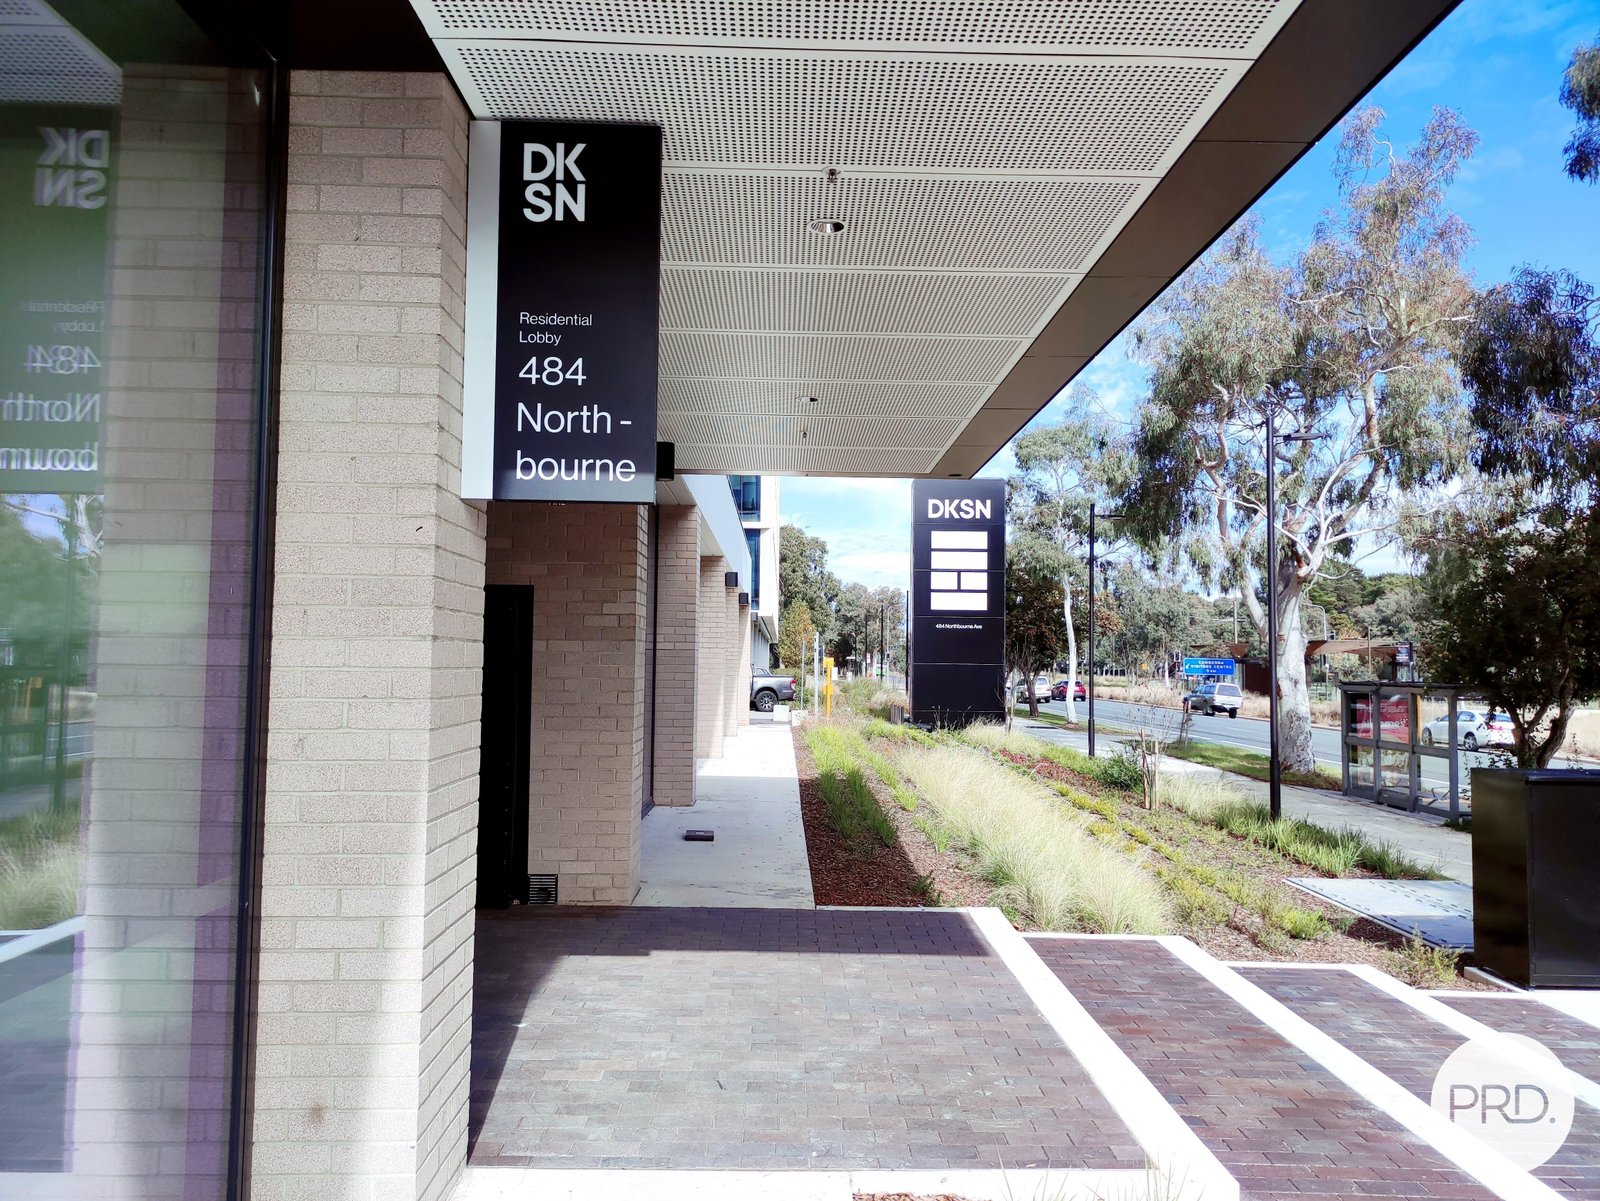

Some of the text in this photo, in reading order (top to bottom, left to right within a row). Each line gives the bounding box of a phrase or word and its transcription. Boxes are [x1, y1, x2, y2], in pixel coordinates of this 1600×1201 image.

[523, 142, 587, 181] DK
[523, 183, 586, 222] SN
[519, 311, 593, 327] Residential
[518, 331, 562, 347] Lobby
[518, 356, 587, 386] 484
[516, 402, 612, 434] North
[515, 449, 636, 482] bourne
[927, 498, 991, 520] DKSN
